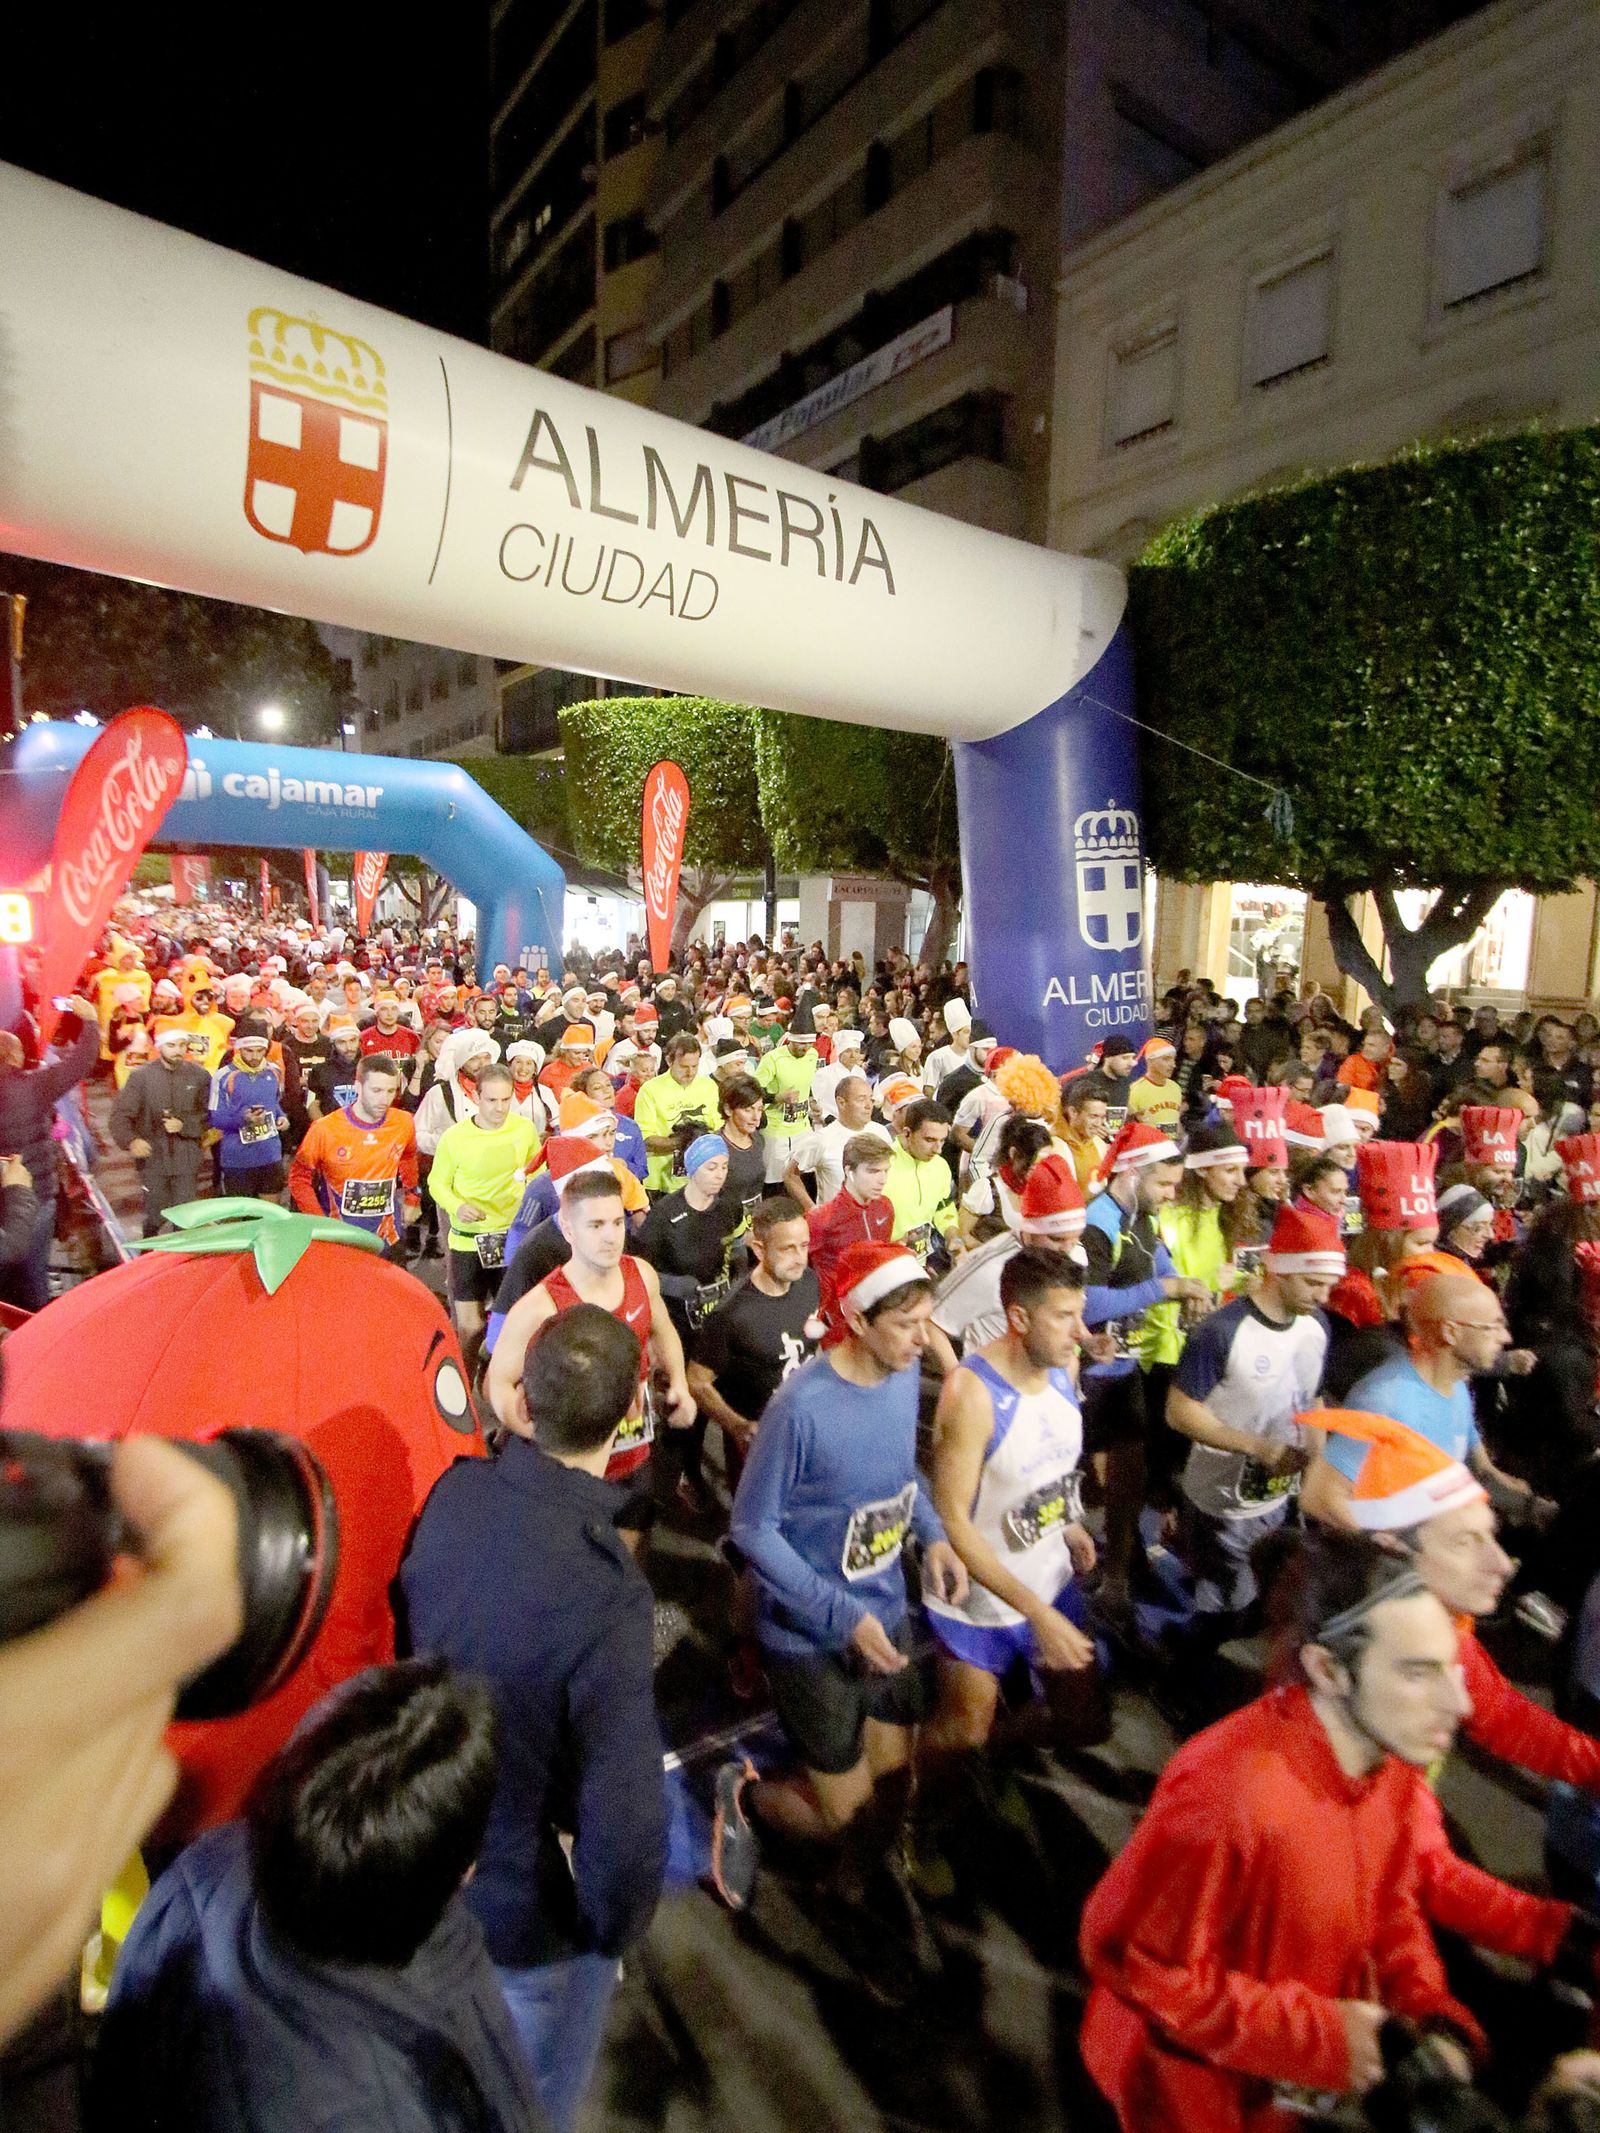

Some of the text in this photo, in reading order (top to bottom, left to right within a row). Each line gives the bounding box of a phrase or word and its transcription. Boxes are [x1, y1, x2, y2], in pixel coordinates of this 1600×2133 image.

[509, 408, 896, 596] ALMERÍA
[498, 523, 719, 621] CIUDAD
[222, 767, 384, 811] cajamar
[340, 807, 379, 820] RURAL
[1085, 1002, 1148, 1028] CIUDAD
[359, 1195, 386, 1208] 2255
